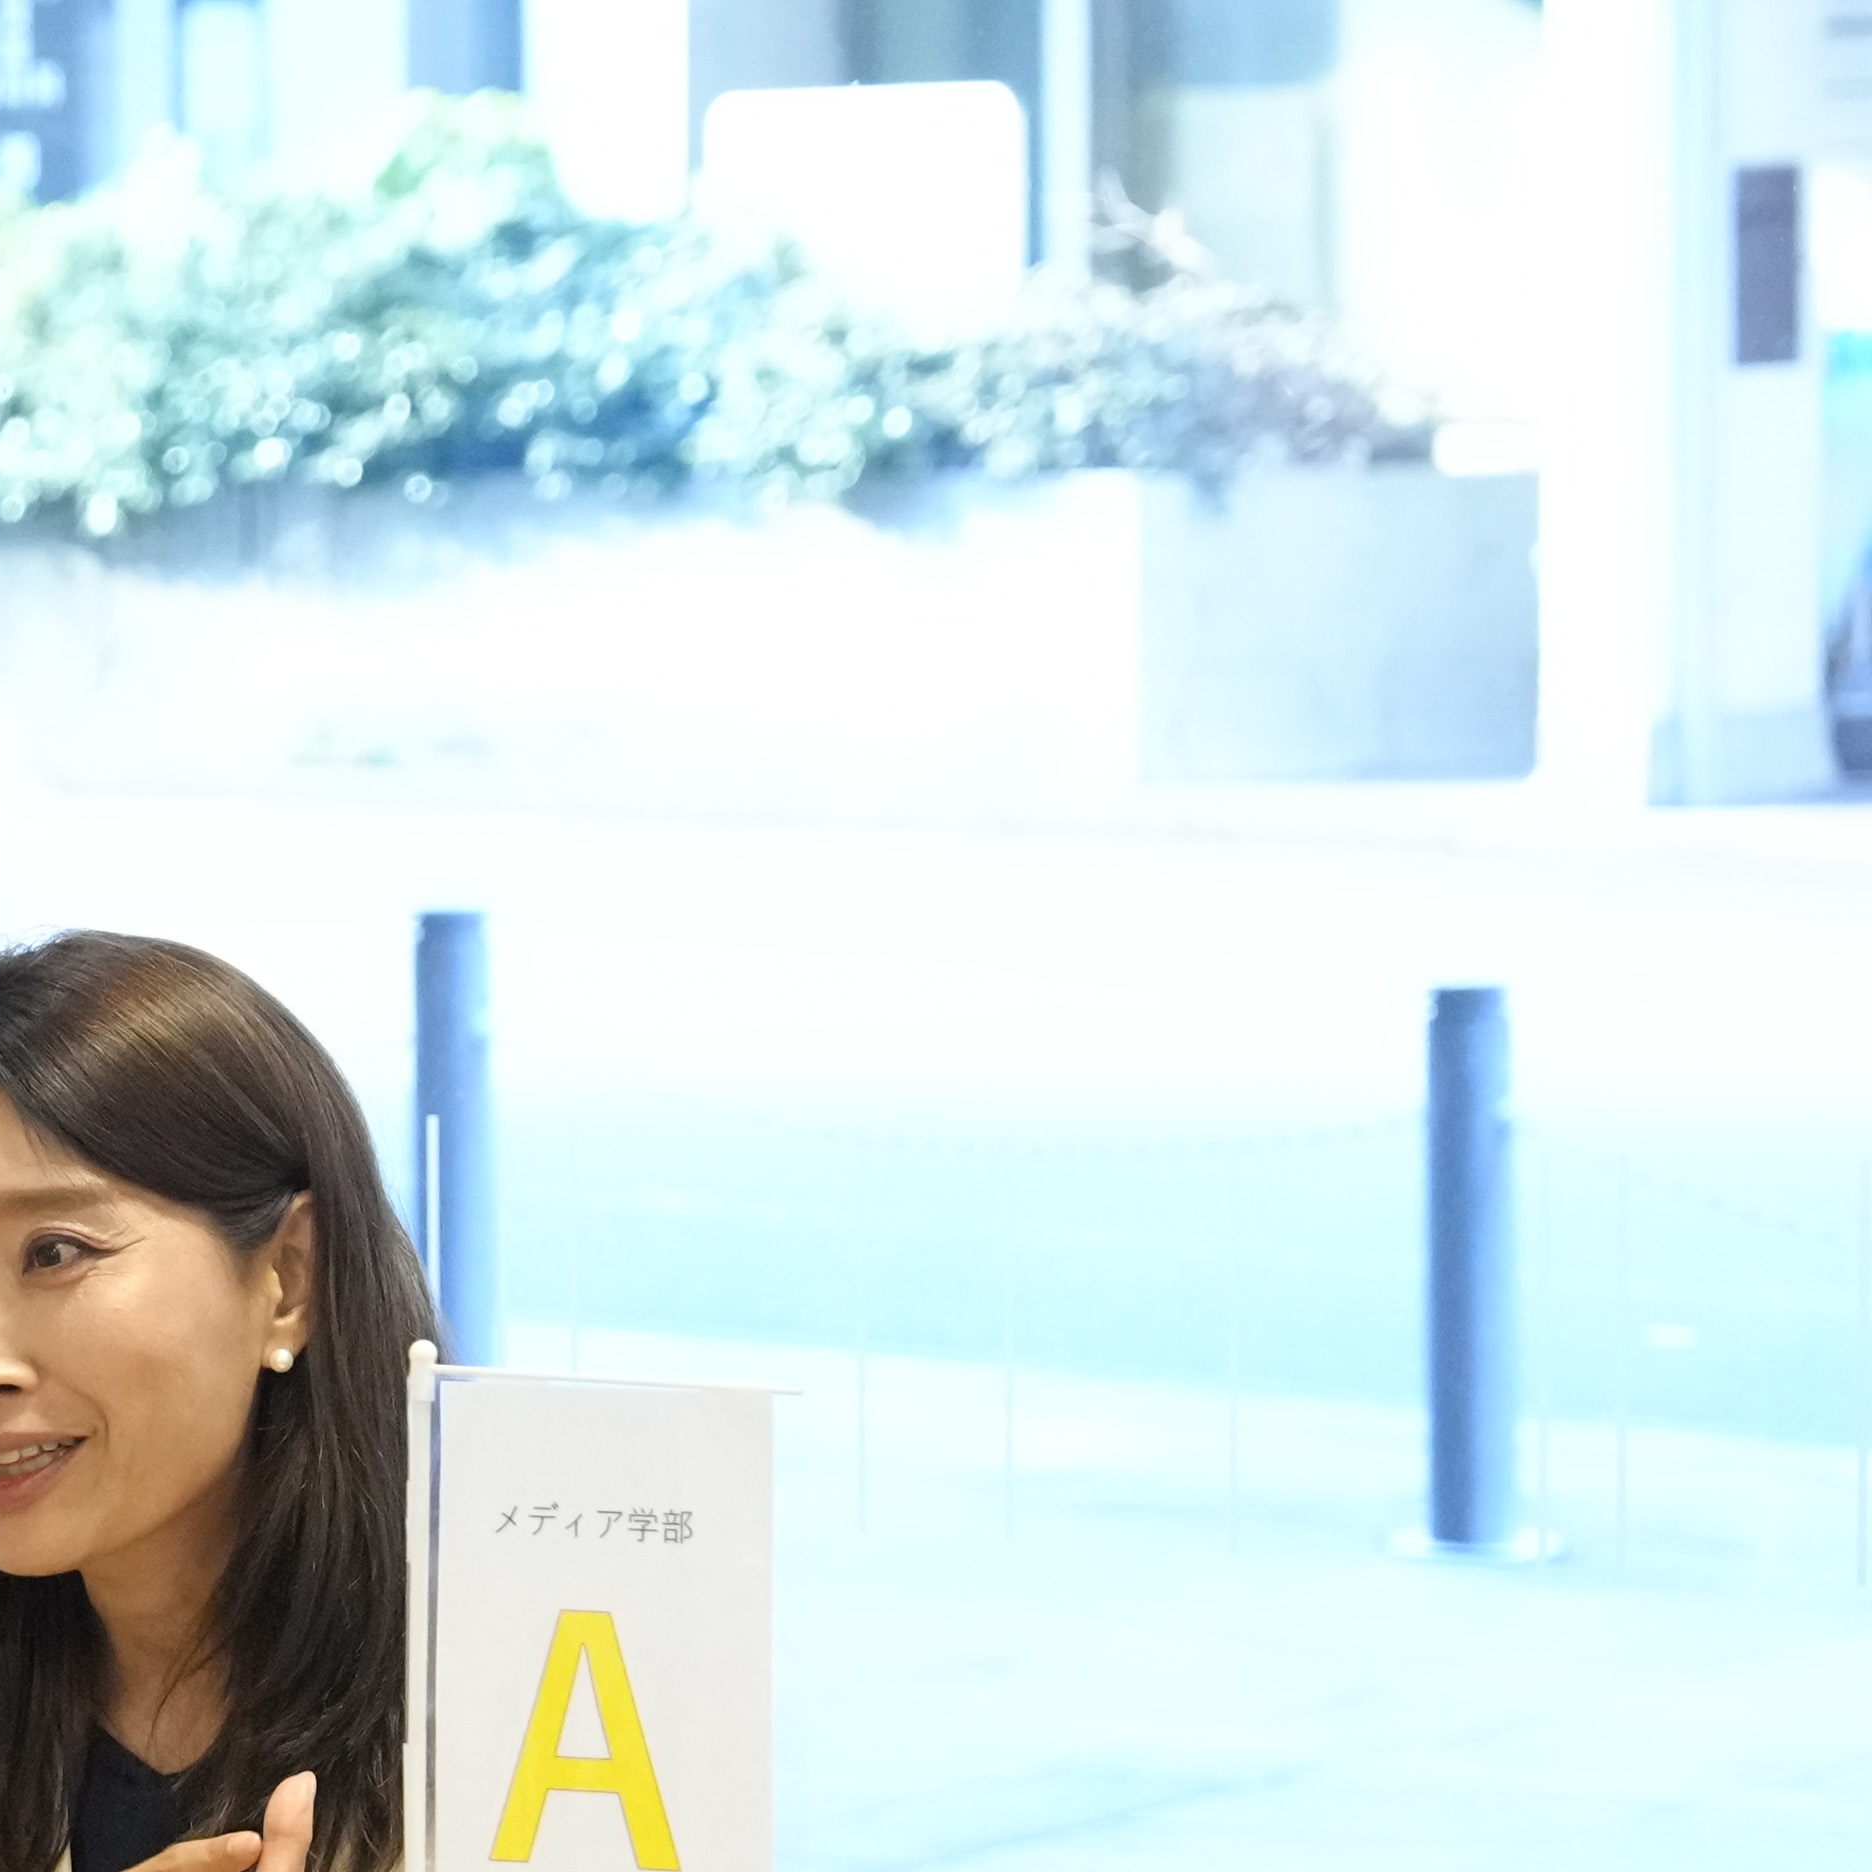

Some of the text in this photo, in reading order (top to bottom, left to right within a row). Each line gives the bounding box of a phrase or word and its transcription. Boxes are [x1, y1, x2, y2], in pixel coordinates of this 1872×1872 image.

[494, 1501, 694, 1544] メディア学部
[488, 1608, 683, 1872] A
